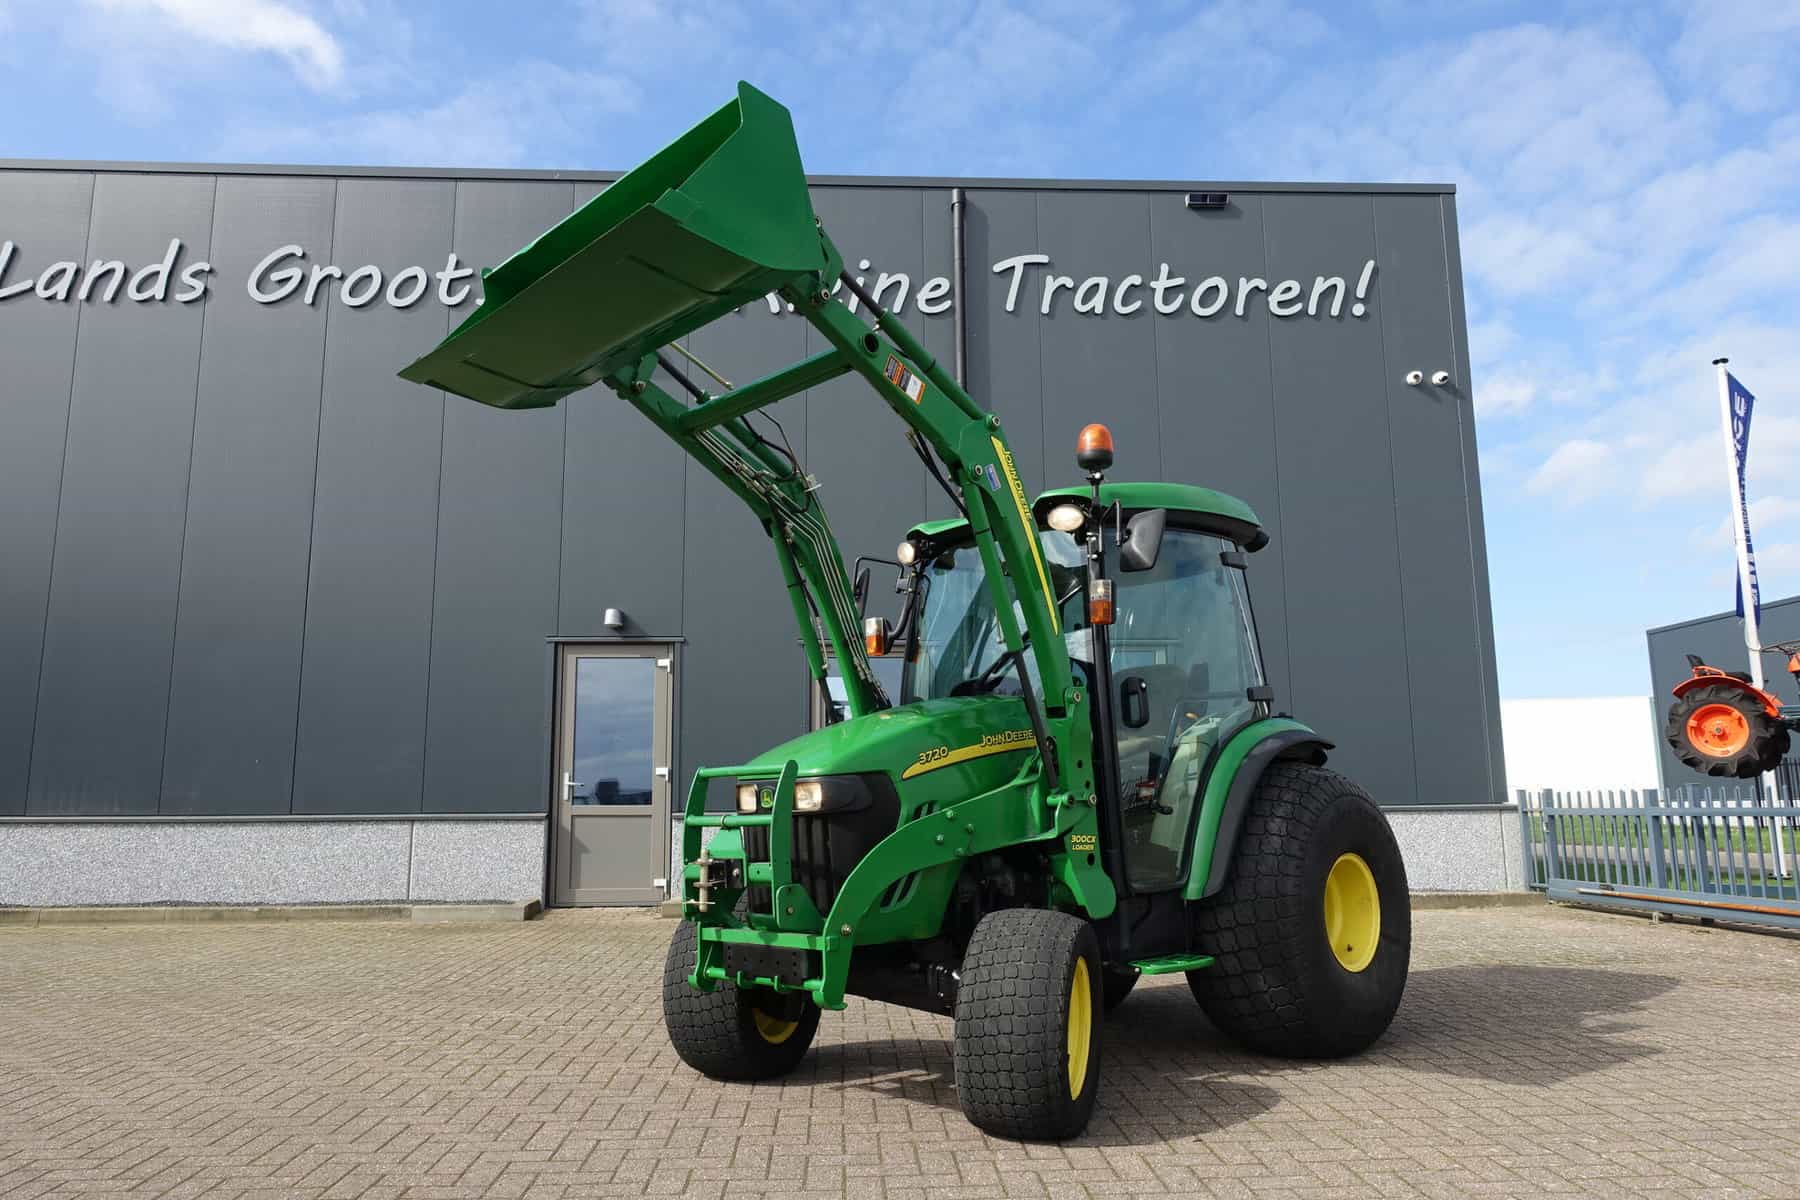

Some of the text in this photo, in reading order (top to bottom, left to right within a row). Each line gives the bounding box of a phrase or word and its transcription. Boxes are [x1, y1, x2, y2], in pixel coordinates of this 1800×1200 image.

[0, 238, 211, 303] Lands
[247, 244, 486, 307] Groot
[992, 253, 1376, 317] Tractoren!
[981, 729, 1034, 747] JOHN DEERE
[919, 746, 949, 764] 3720
